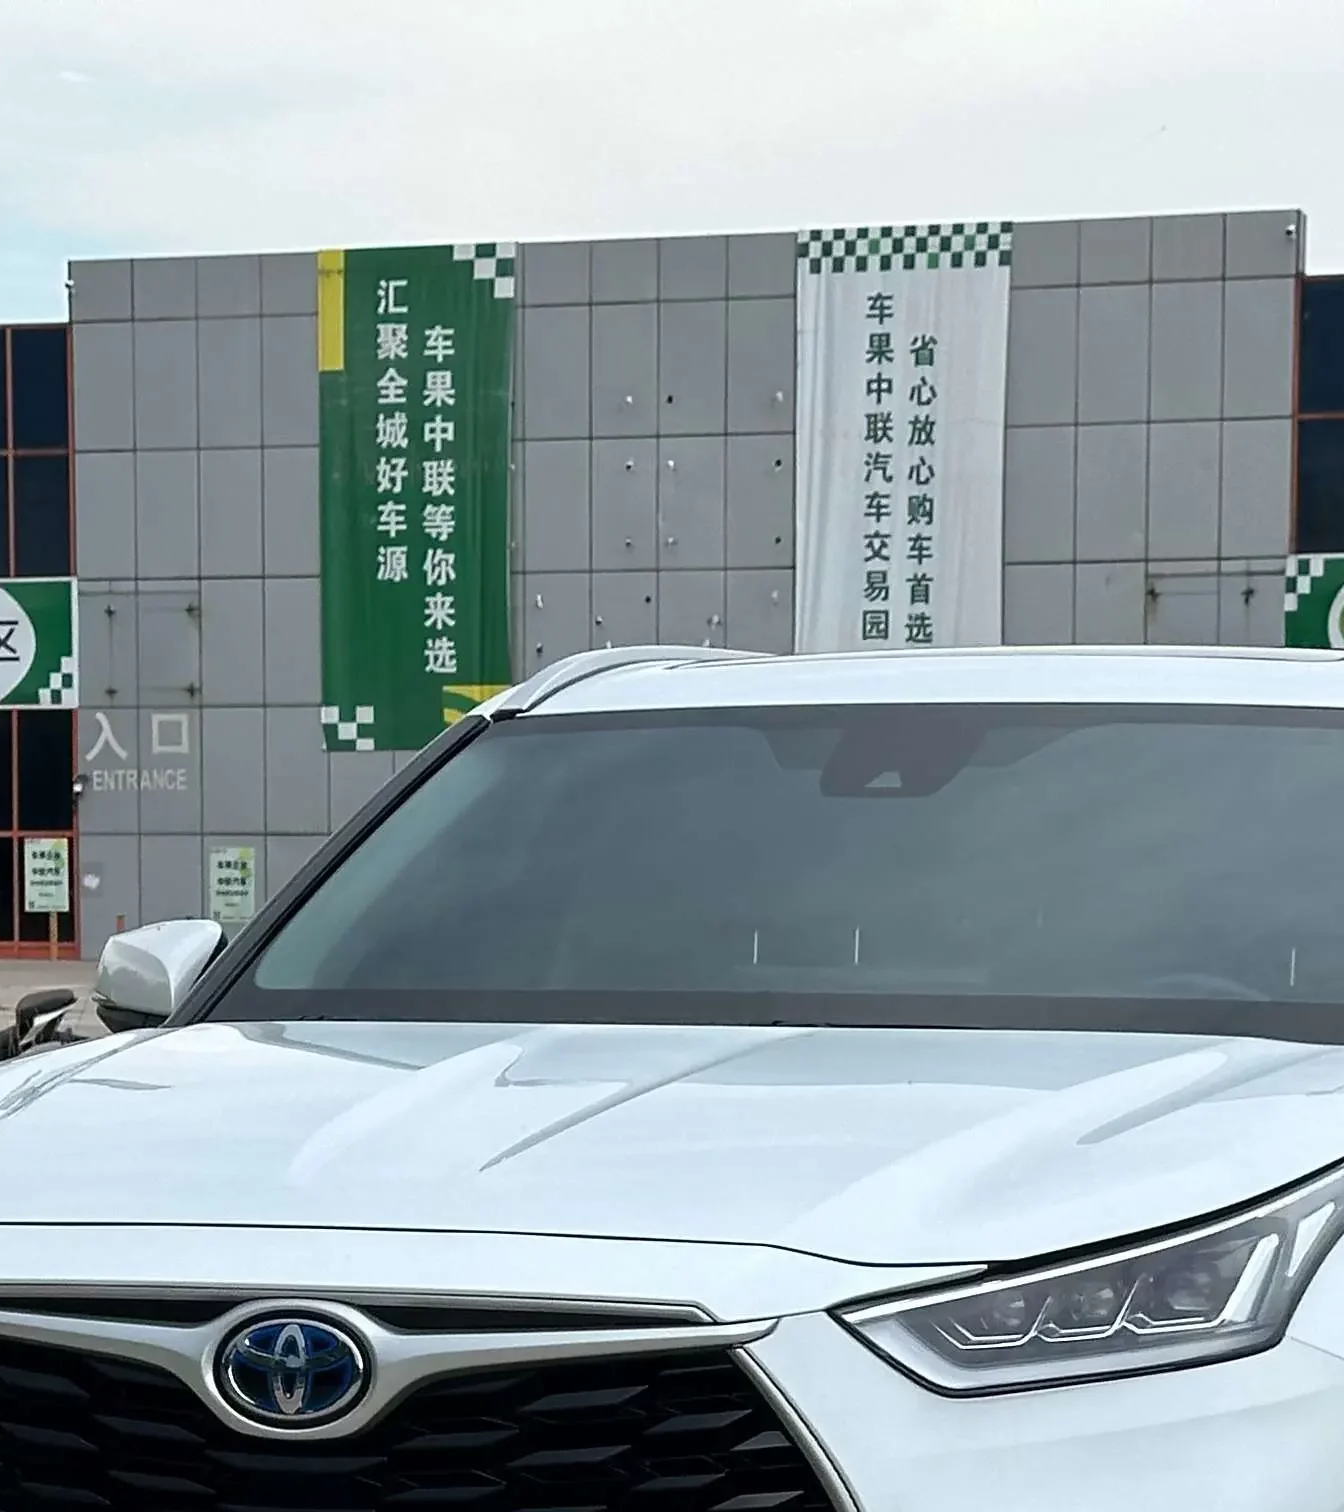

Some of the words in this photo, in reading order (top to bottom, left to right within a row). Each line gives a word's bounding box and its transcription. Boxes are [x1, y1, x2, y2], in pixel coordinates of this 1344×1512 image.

[376, 278, 410, 582] 汇聚全城好车源
[422, 325, 458, 675] 车果中联等你来选
[862, 291, 895, 642] 车果中联汽车交易园
[904, 333, 938, 650] 省心放心购车首选
[85, 711, 190, 761] 入口
[92, 768, 189, 792] ENTRANCE
